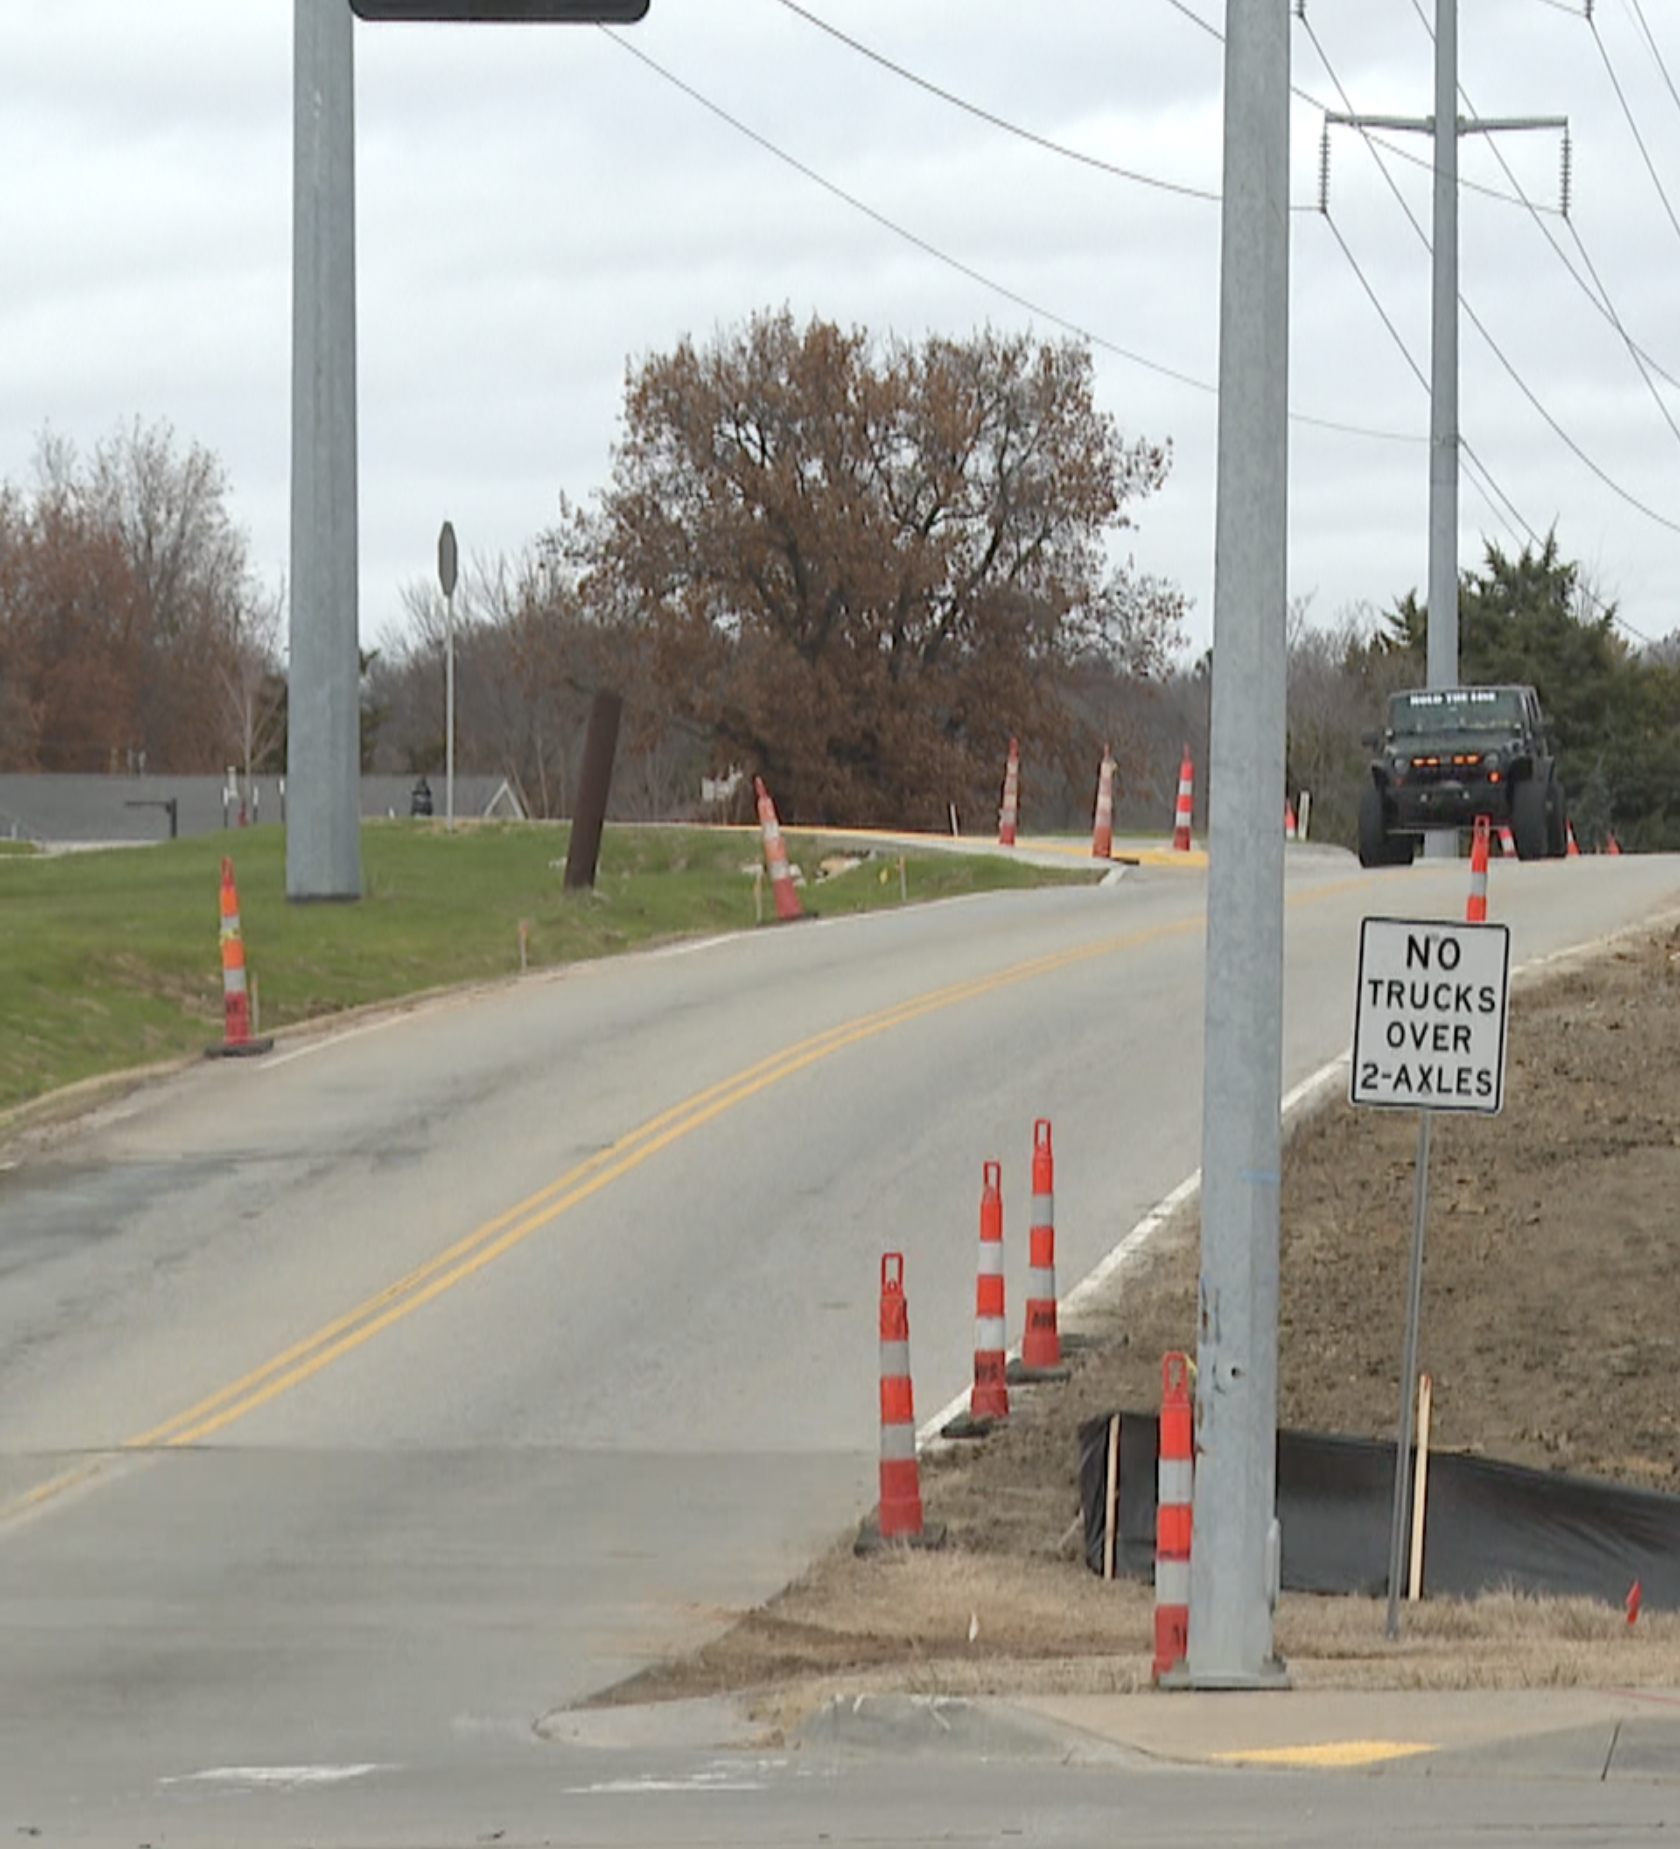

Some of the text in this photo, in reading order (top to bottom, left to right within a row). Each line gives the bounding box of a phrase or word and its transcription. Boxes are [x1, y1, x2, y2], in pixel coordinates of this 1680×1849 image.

[1407, 934, 1461, 971] NO
[1368, 979, 1496, 1014] TRUCKS
[1386, 1021, 1472, 1054] OVER
[1361, 1062, 1493, 1097] 2-AXLES
